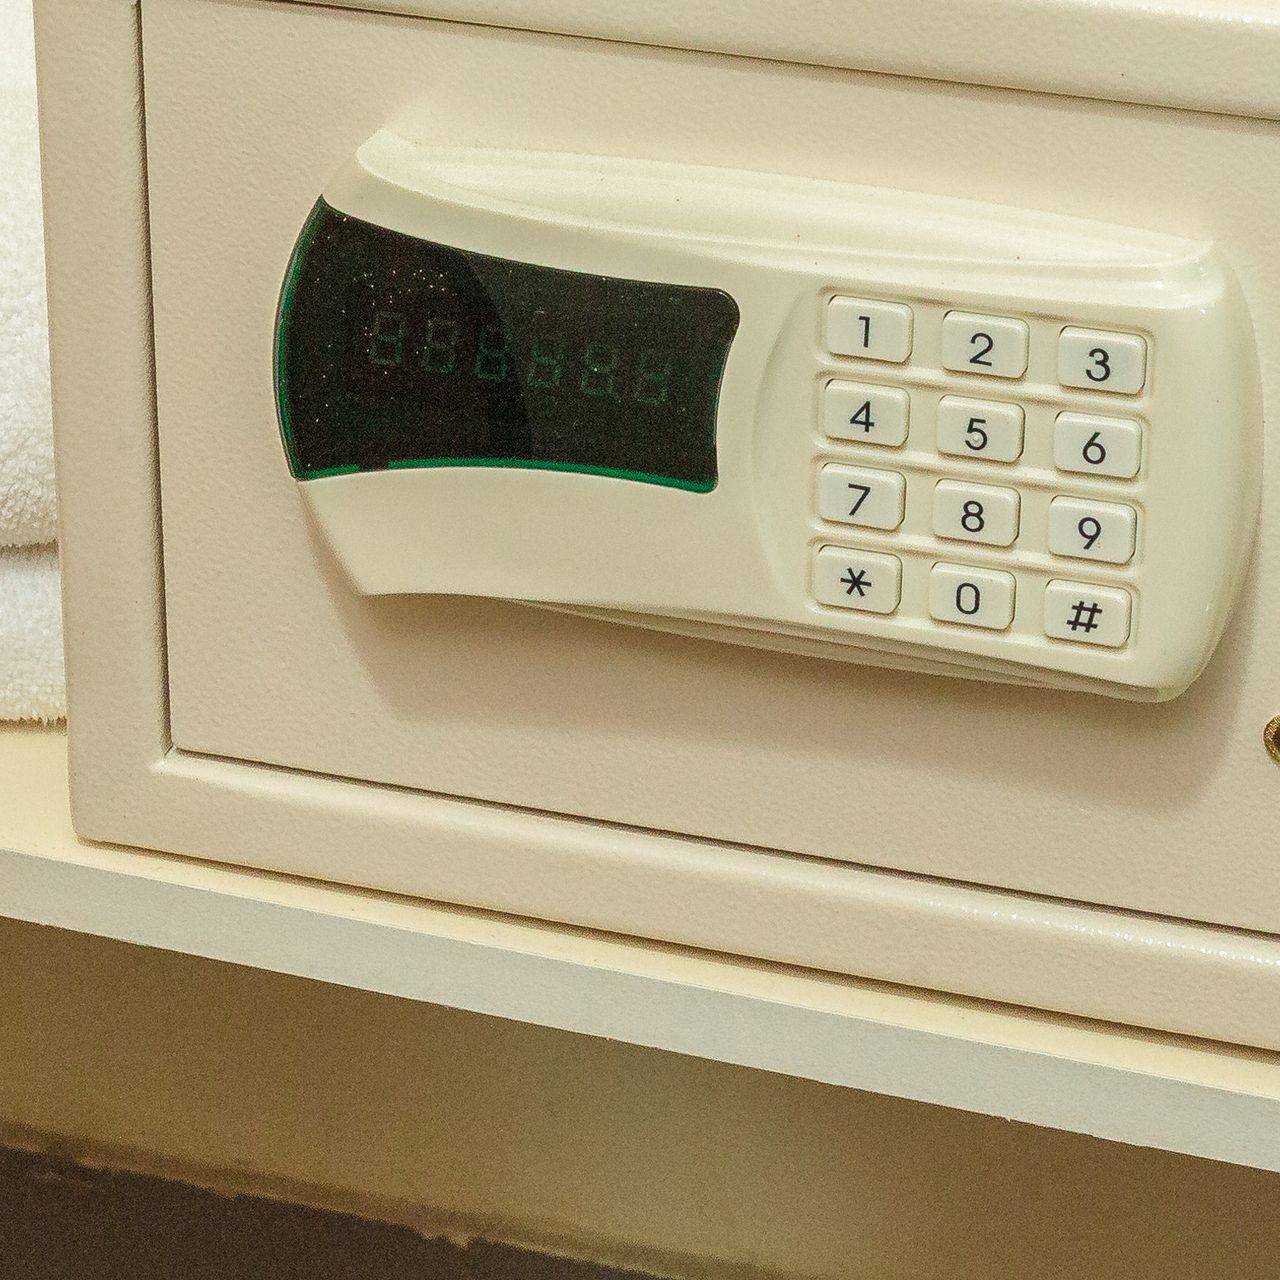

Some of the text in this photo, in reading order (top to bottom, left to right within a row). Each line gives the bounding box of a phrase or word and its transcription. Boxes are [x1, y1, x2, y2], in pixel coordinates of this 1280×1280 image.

[858, 316, 1110, 382] 1 2 3
[850, 401, 1106, 464] 4 5 6
[848, 483, 1101, 550] 7 8 9
[956, 582, 980, 615] 0
[1067, 600, 1103, 633] #
